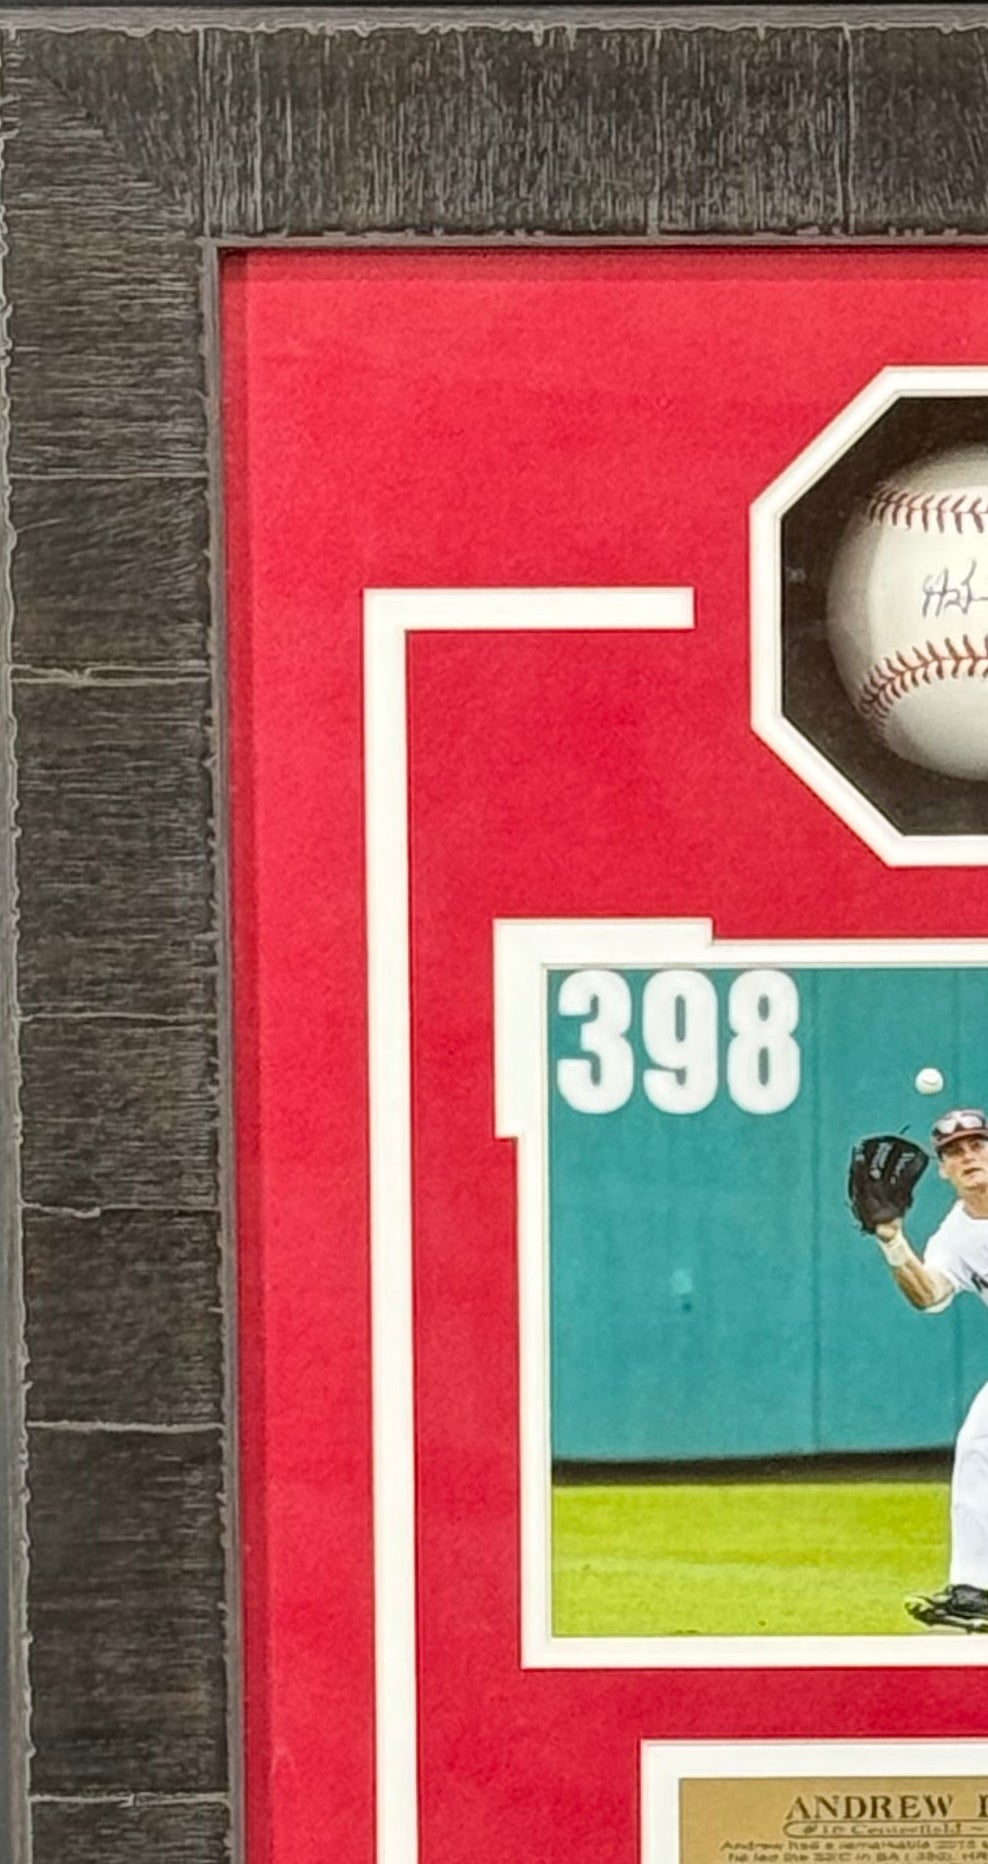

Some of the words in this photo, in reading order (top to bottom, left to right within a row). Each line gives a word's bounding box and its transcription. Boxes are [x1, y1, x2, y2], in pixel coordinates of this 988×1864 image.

[557, 969, 801, 1115] 398
[785, 1795, 954, 1820] ANDREW
[720, 1841, 783, 1851] Andrew
[789, 1841, 819, 1850] had
[877, 1852, 900, 1861] BA
